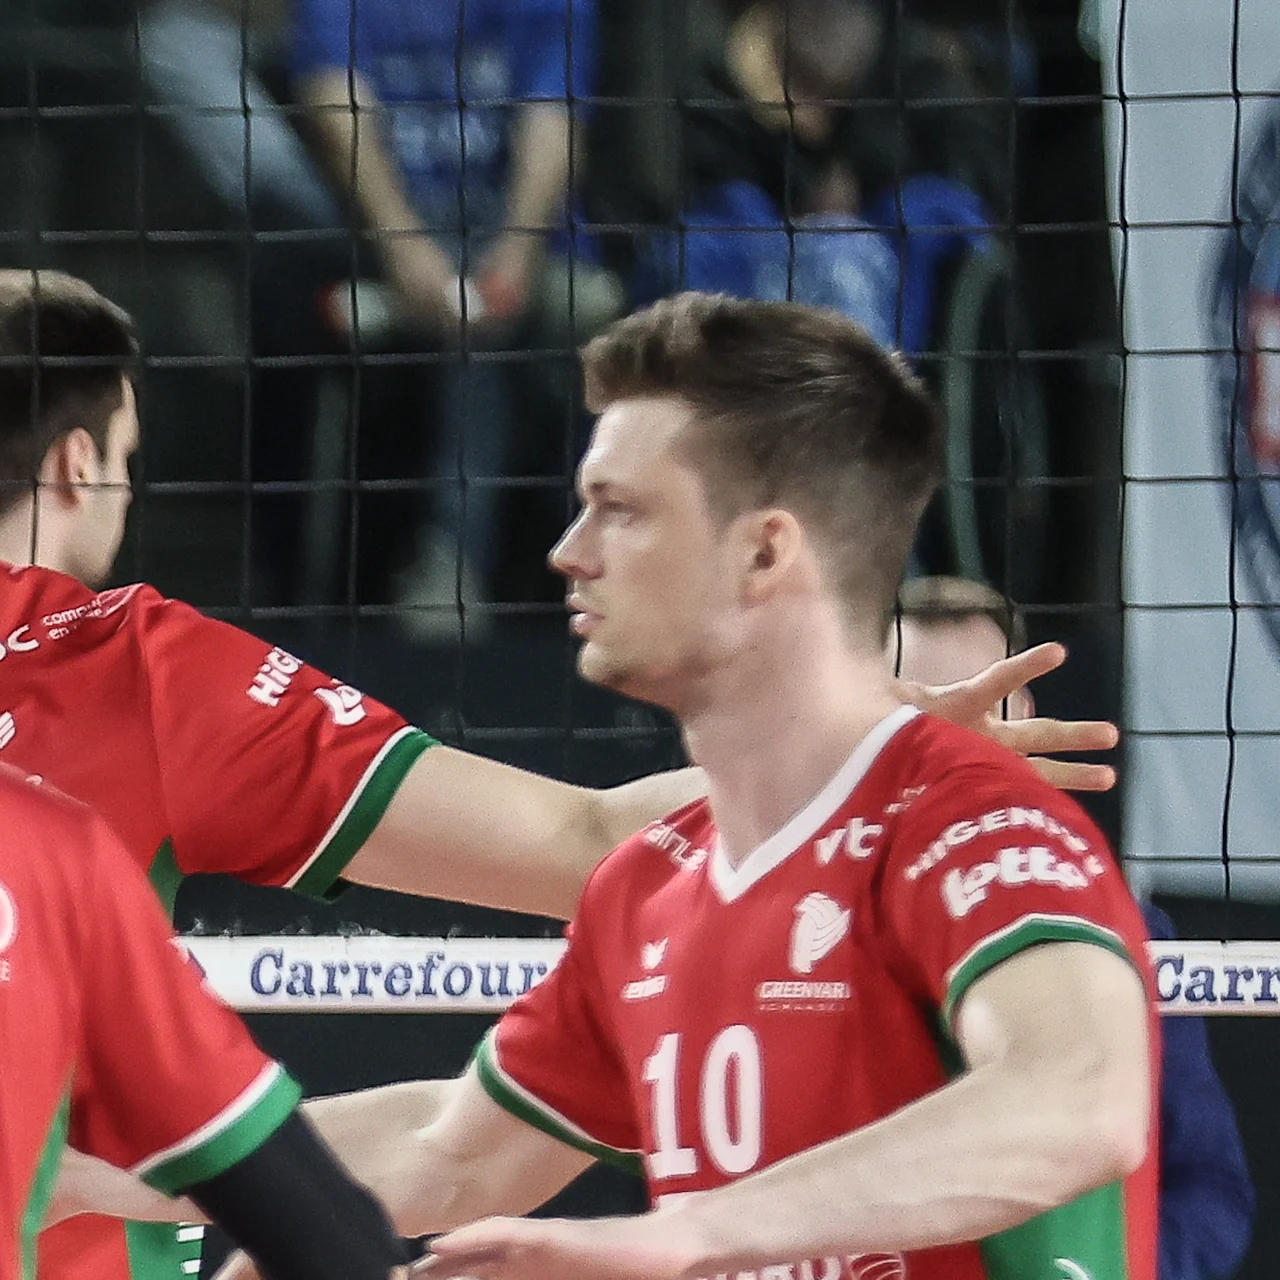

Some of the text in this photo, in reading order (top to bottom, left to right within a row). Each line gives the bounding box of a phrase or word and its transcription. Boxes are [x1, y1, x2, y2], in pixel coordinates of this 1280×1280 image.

[249, 948, 548, 999] Carrefour
[1156, 953, 1280, 1002] Carr
[643, 1023, 763, 1178] 10
